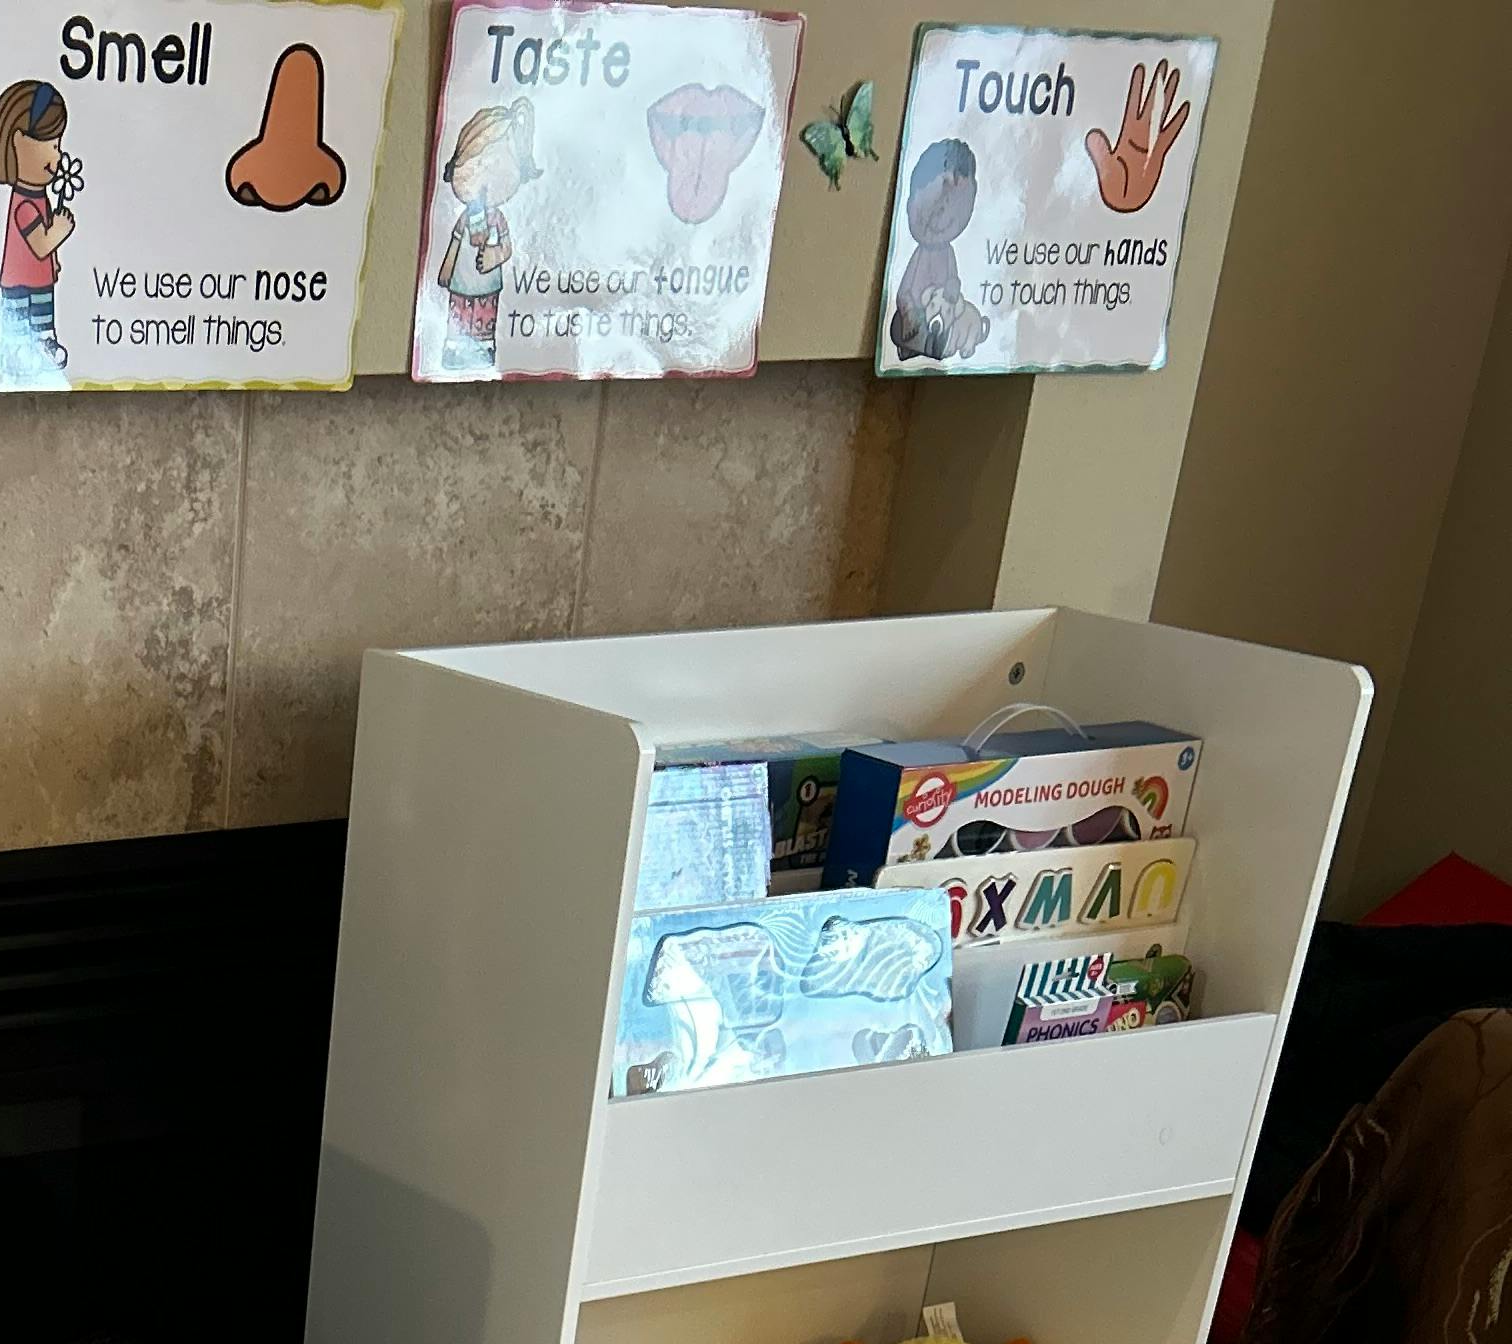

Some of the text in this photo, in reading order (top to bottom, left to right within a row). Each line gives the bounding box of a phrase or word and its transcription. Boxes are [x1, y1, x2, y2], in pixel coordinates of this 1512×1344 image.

[60, 15, 212, 85] Smell
[488, 25, 631, 87] Taste
[956, 59, 1075, 116] Touch
[985, 238, 1168, 267] We use our hands
[93, 267, 327, 302] We use our nose
[512, 264, 749, 297] We use our tongue
[979, 279, 1004, 306] to
[1010, 277, 1066, 306] touch
[92, 314, 286, 352] to smell things.
[508, 310, 692, 342] to taste things.
[974, 777, 1125, 808] MODELING DOUGH
[1027, 1017, 1100, 1042] PHONICS
